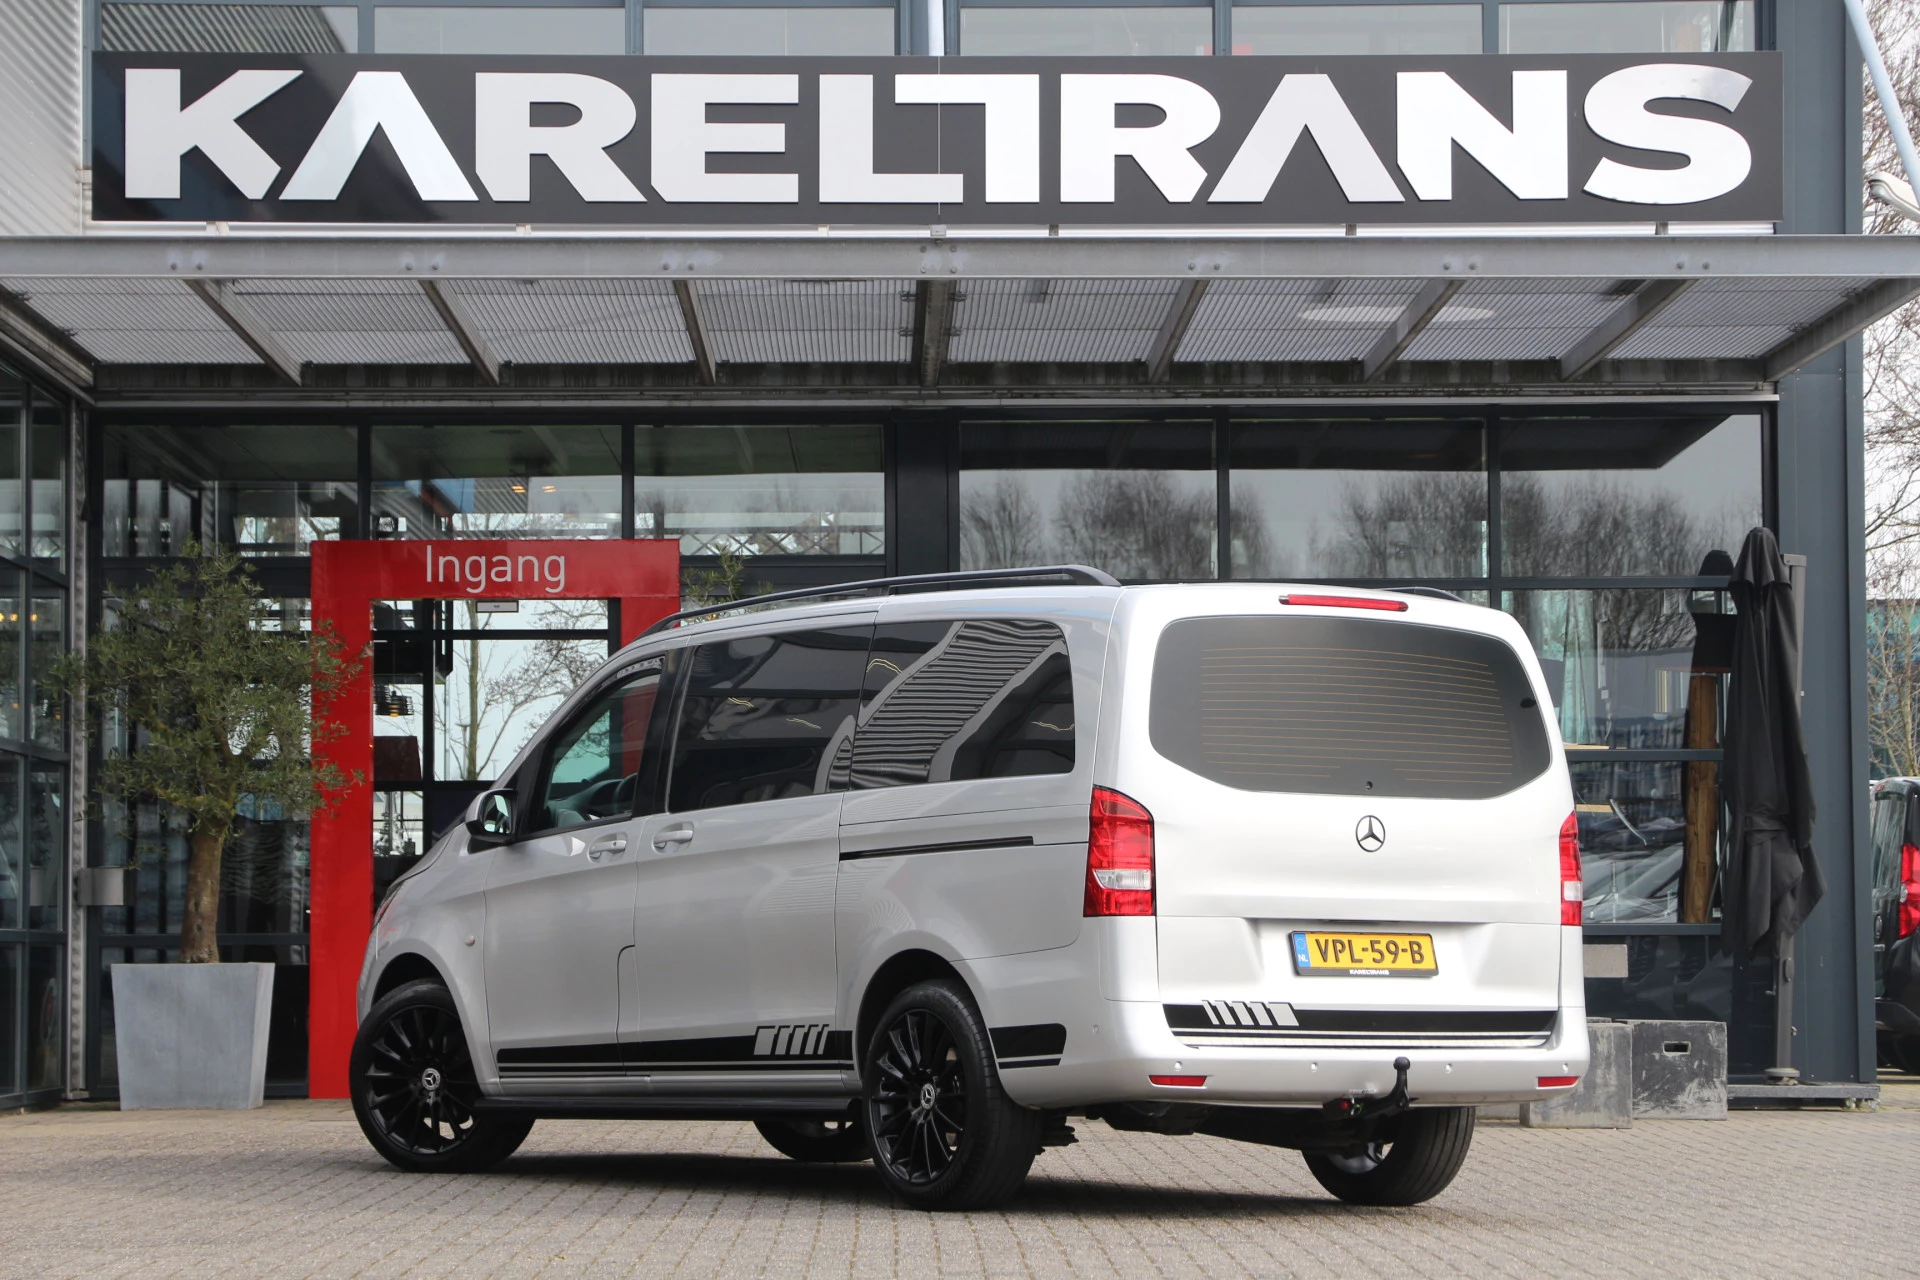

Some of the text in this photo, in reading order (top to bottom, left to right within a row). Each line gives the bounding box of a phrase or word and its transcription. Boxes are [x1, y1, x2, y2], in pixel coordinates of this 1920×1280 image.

[125, 63, 1752, 205] KARELTRANS
[426, 545, 565, 593] Ingang
[1298, 955, 1309, 963] NL
[1315, 938, 1425, 964] VPL-59-B
